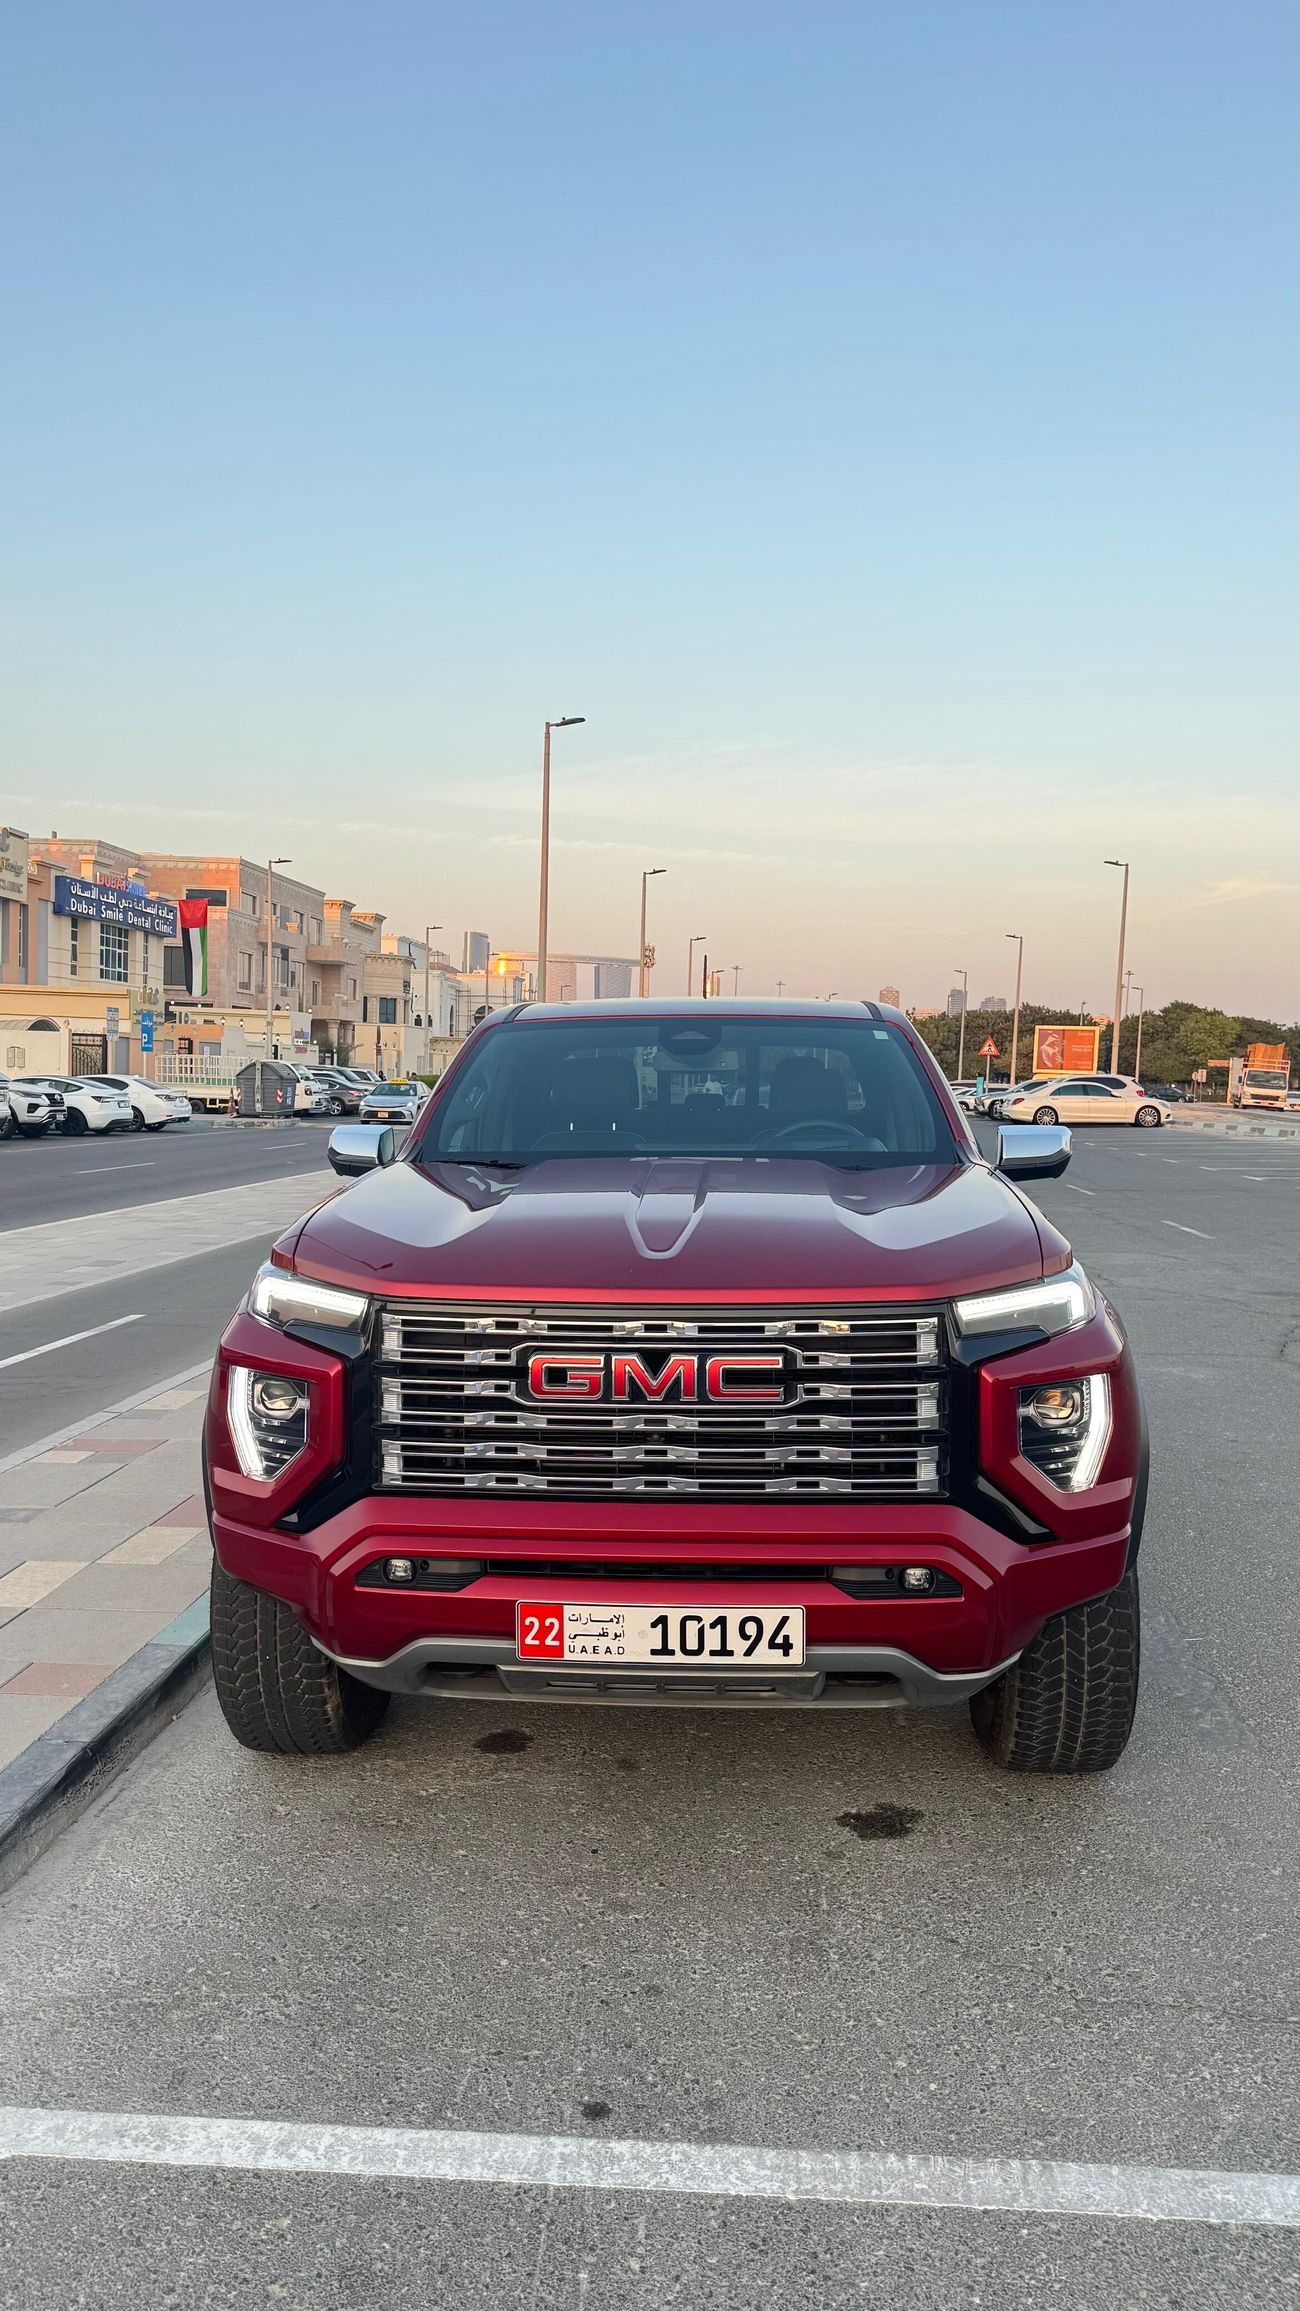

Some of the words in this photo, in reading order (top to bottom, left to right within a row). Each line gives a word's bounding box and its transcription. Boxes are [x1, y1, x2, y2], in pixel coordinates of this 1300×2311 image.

[100, 890, 117, 905] لطب
[118, 898, 132, 911] دبي
[70, 898, 96, 916] Dubai
[101, 904, 124, 922] Smile
[128, 911, 151, 929] Dental
[154, 918, 173, 934] Clinic
[159, 906, 174, 921] عيادة
[528, 1355, 784, 1401] GMC
[524, 1616, 561, 1647] 22
[650, 1614, 794, 1657] 10194
